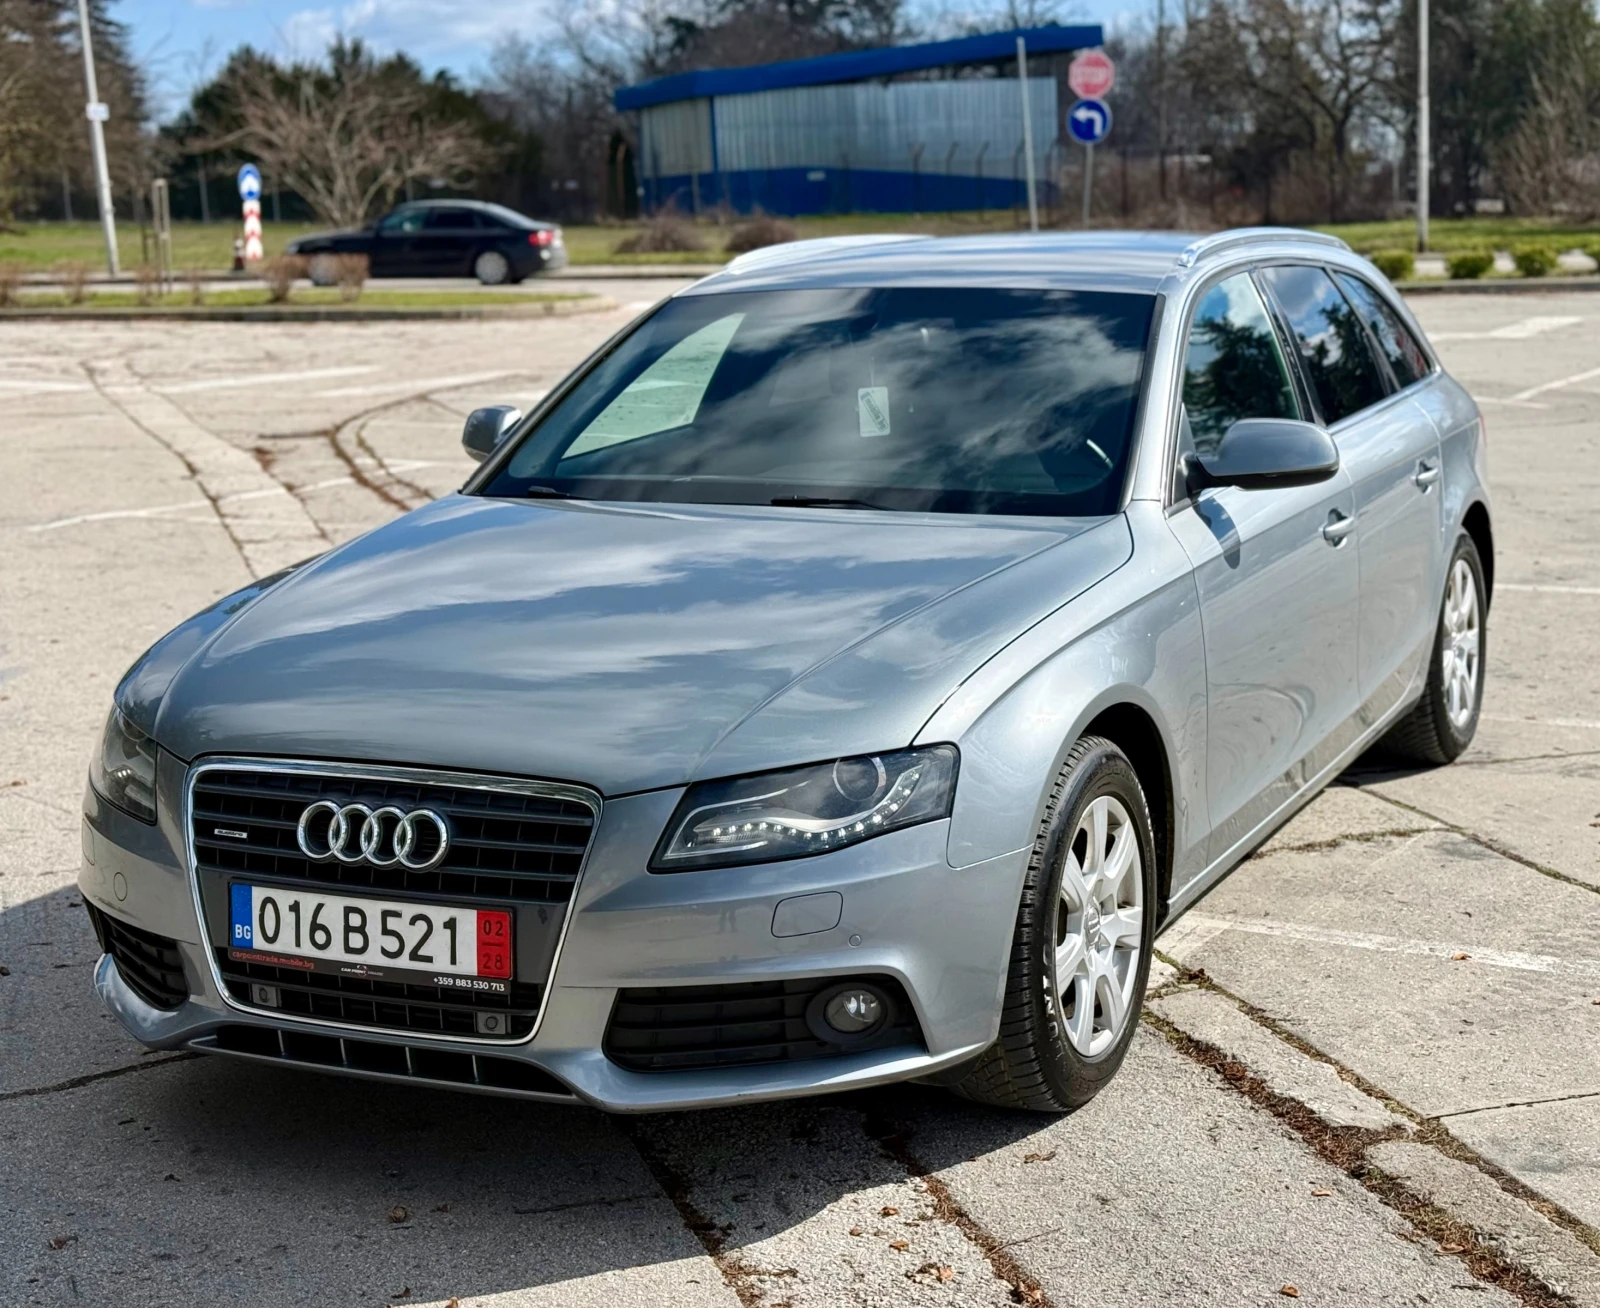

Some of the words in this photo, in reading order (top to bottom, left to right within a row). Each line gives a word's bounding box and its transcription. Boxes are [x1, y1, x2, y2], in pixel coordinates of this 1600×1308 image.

[234, 924, 252, 940] BG
[482, 919, 504, 937] 02
[232, 951, 315, 970] carpointtrade.mobile.bg
[482, 952, 504, 971] 28
[433, 976, 454, 986] +359
[455, 978, 472, 988] 883
[473, 980, 489, 990] 530
[490, 982, 505, 992] 713
